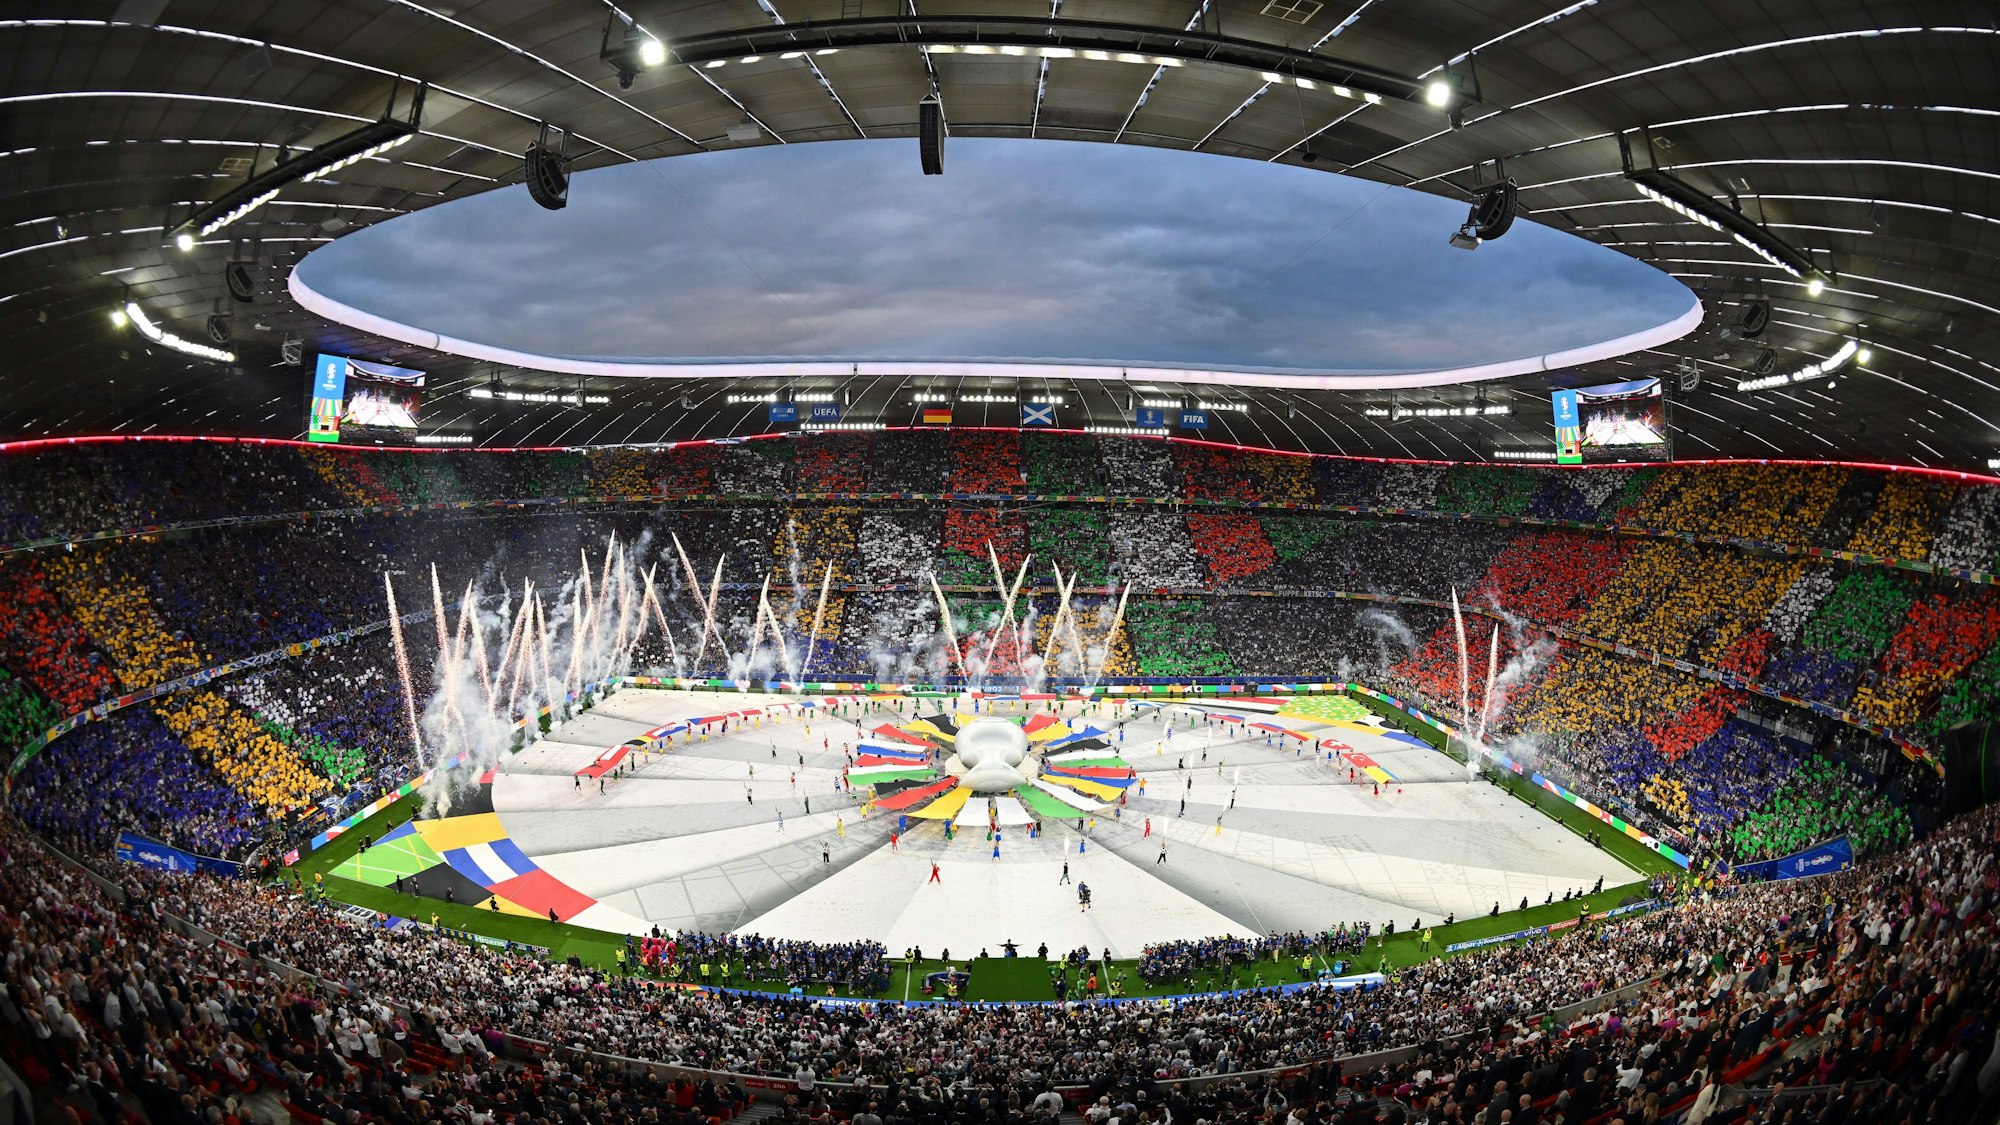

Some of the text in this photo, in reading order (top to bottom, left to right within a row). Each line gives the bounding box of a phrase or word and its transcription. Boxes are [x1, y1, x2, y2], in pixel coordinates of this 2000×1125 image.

[814, 408, 837, 416] UEFA
[1183, 415, 1204, 424] FIFA
[1912, 563, 1933, 572] MUNICH
[1524, 928, 1542, 936] vivo
[475, 935, 505, 947] Hisens
